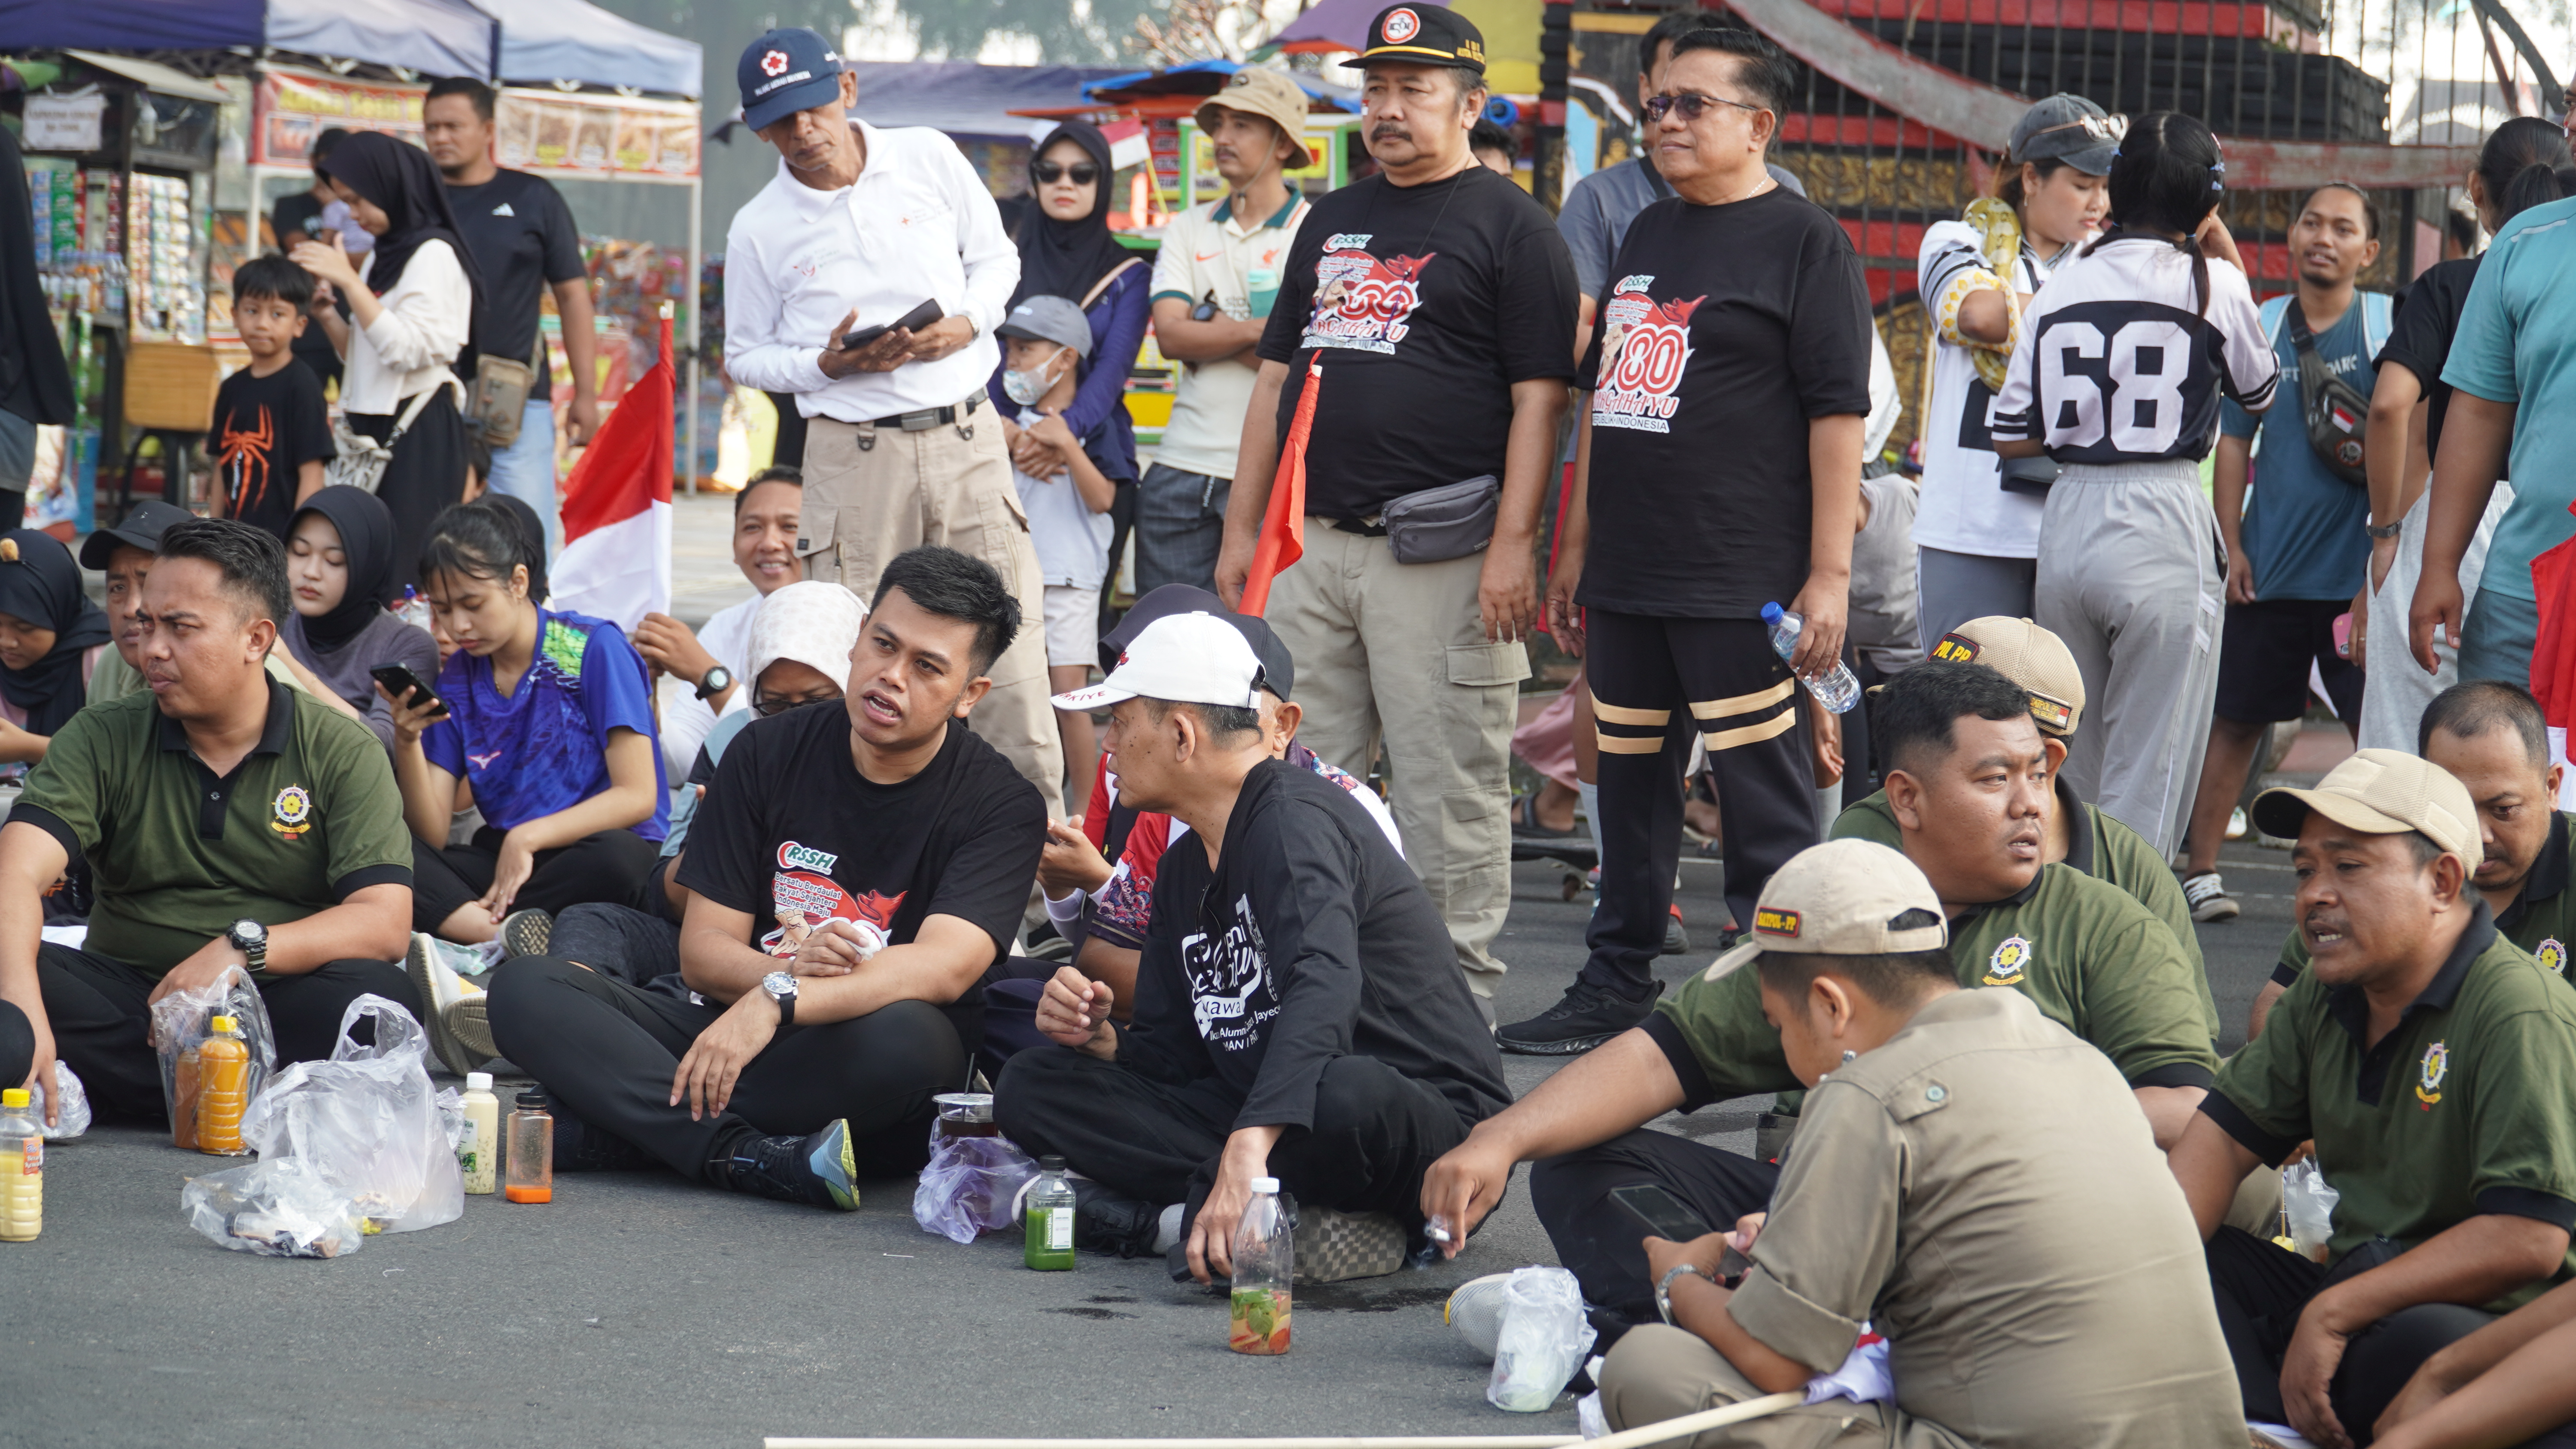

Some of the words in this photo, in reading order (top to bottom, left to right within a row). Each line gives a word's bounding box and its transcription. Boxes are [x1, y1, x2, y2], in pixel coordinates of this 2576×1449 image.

[1624, 276, 1649, 287] RSSH
[1617, 327, 1685, 394] 80
[2040, 321, 2191, 453] 68
[1616, 416, 1667, 430] INDONESIA
[1948, 646, 1971, 662] PP
[787, 846, 834, 868] RSSH
[775, 873, 803, 887] Bersatu
[804, 882, 841, 899] Berdaulat
[775, 883, 799, 896] Rakyat
[800, 891, 836, 907] Sejahtera
[776, 894, 811, 910] Indonesia
[812, 905, 830, 917] Maju
[1223, 1040, 1244, 1051] MAN
